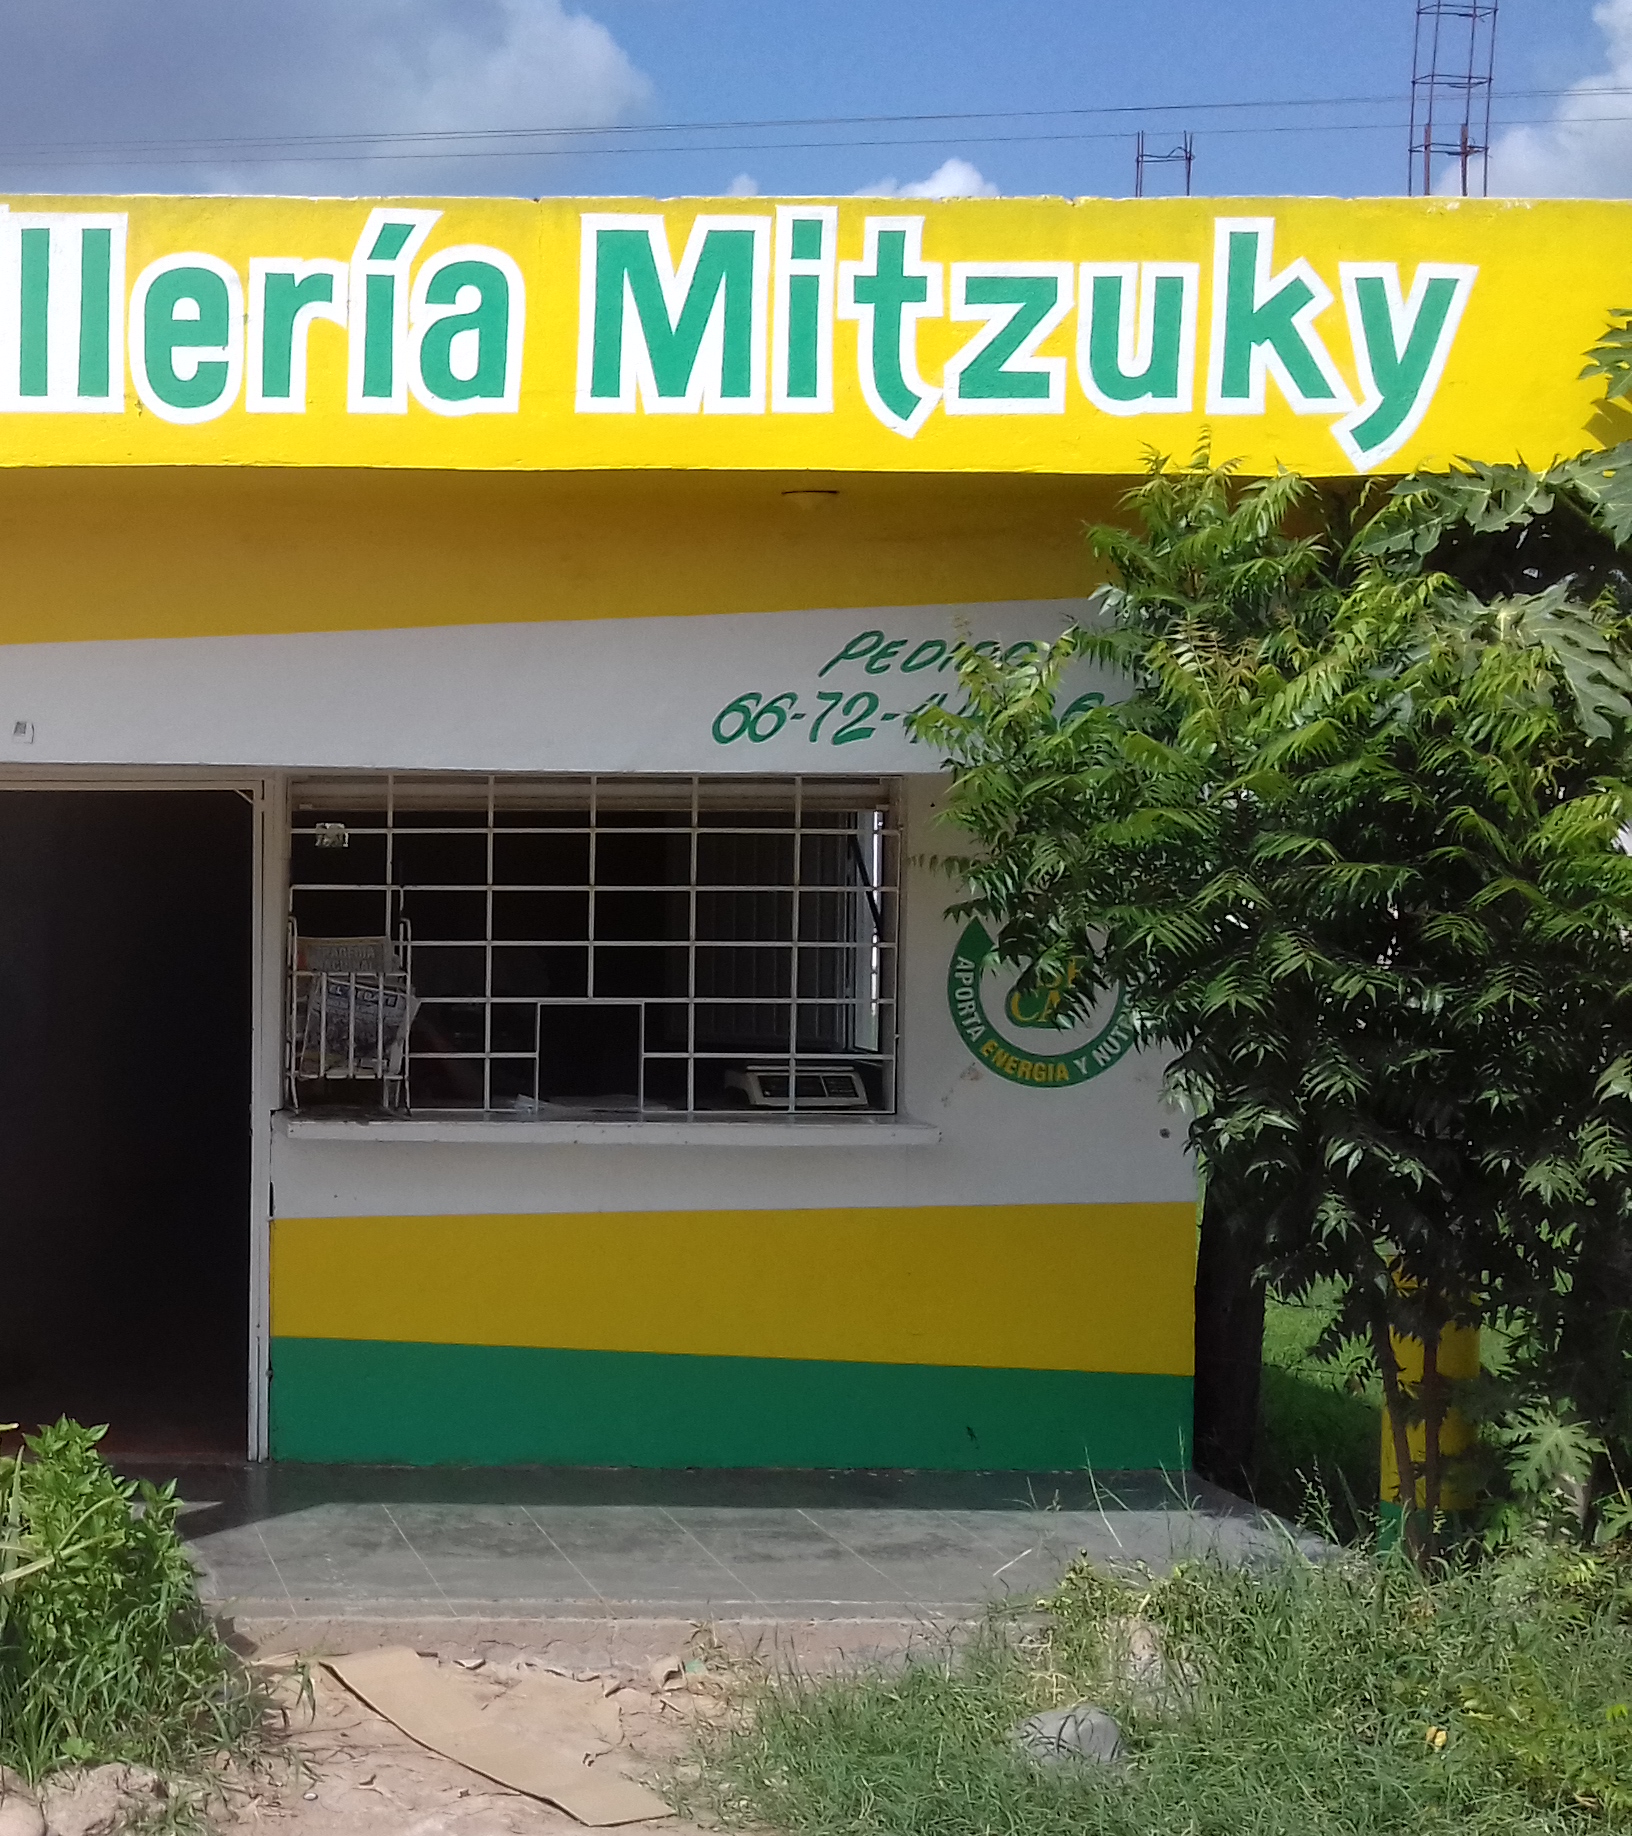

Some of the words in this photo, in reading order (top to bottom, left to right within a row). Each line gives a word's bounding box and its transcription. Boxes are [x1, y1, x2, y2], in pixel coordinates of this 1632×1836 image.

[575, 205, 1478, 473] Mitzuky
[954, 956, 987, 1042] APORTA
[981, 1039, 1069, 1083] ENERGIA
[1073, 1056, 1088, 1076] Y
